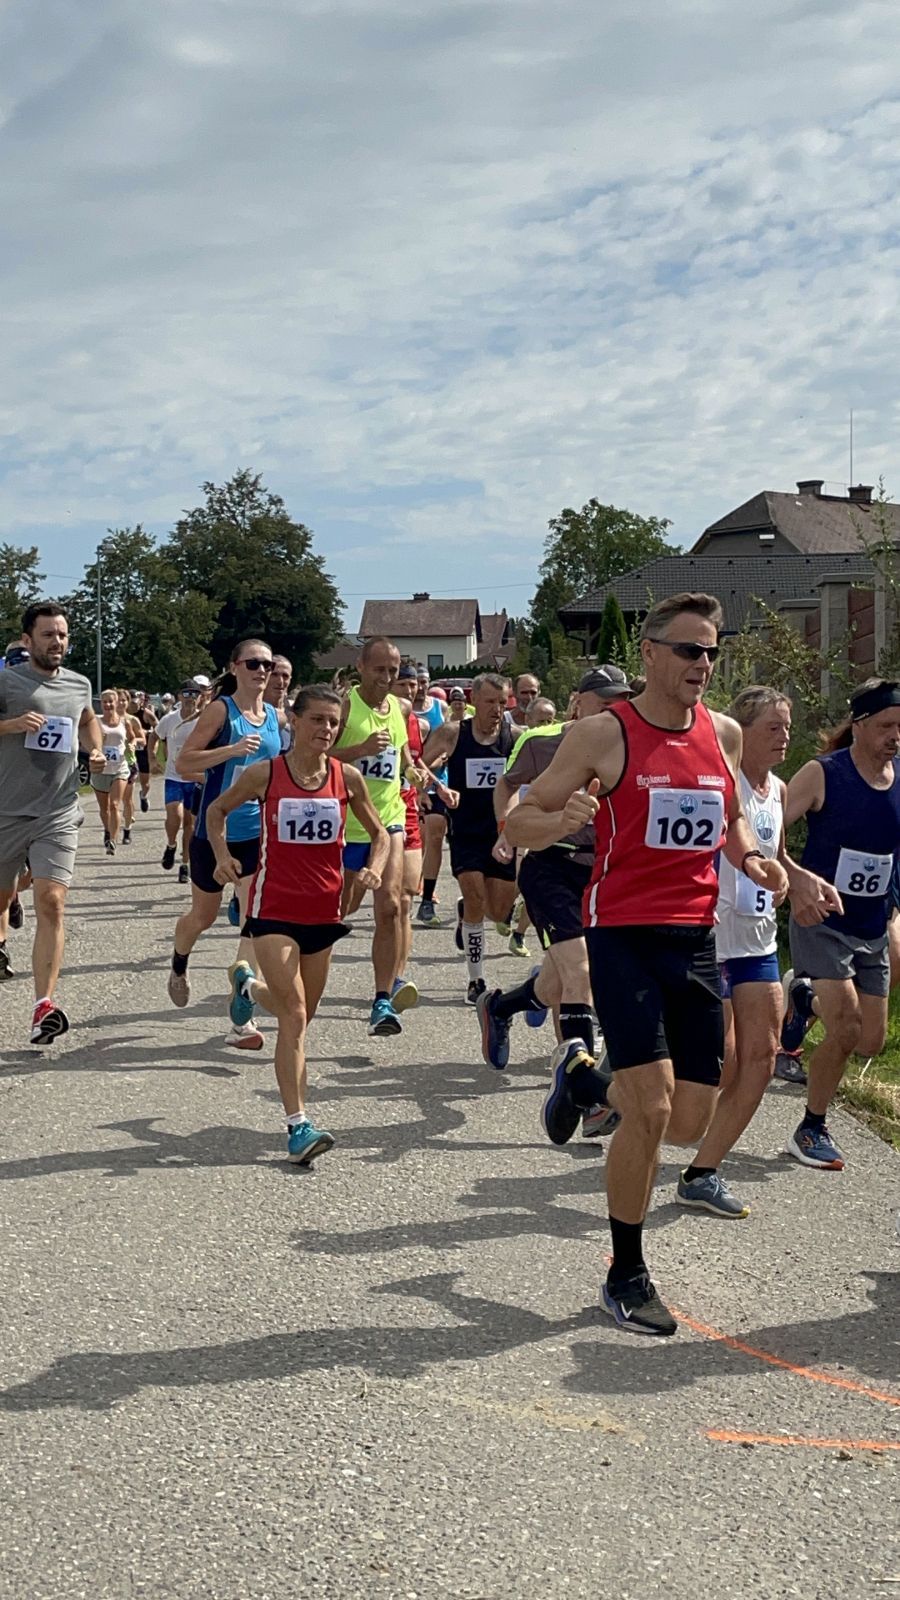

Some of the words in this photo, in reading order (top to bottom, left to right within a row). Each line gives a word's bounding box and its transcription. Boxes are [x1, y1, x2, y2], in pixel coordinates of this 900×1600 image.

[37, 732, 63, 749] 67
[360, 760, 395, 779] 142
[476, 772, 497, 786] 76
[286, 819, 332, 841] 148
[657, 817, 714, 846] 102
[848, 872, 881, 894] 86
[755, 890, 766, 913] 5
[467, 931, 482, 963] eleven
